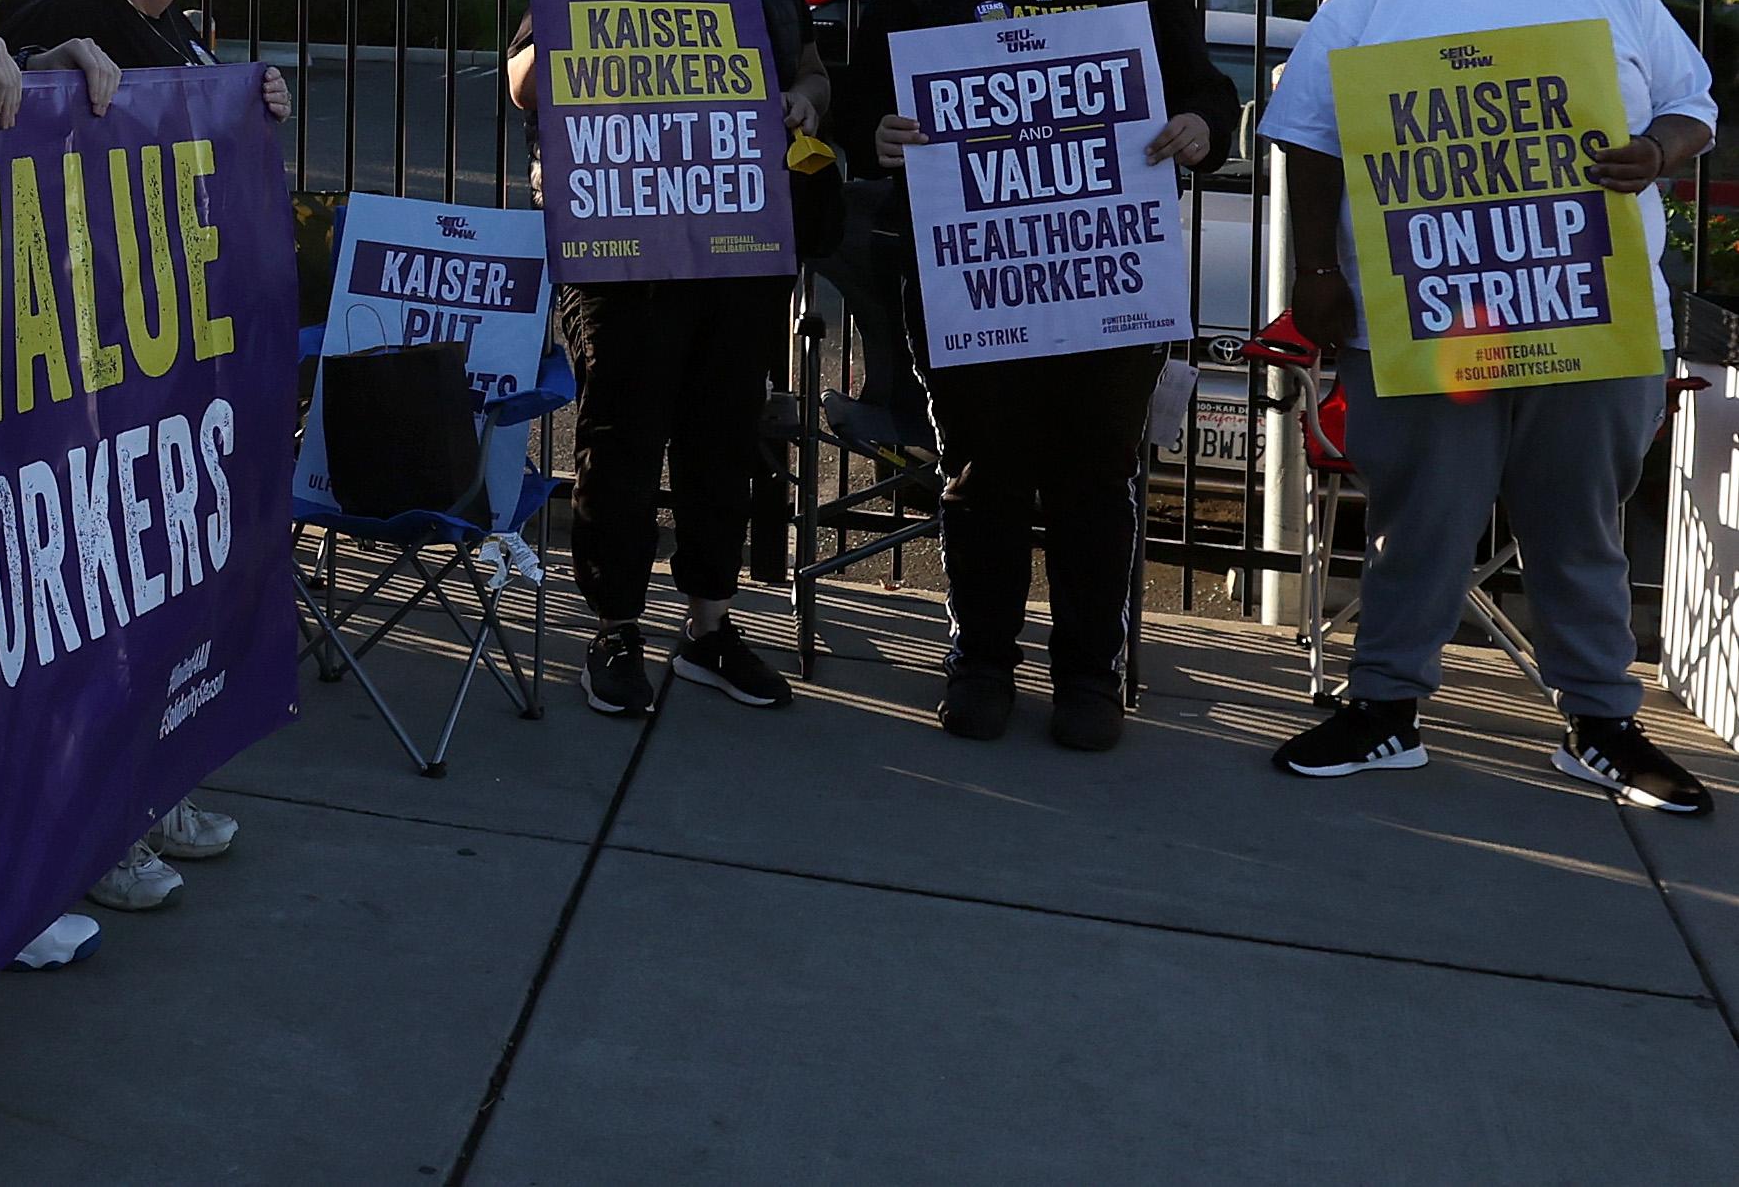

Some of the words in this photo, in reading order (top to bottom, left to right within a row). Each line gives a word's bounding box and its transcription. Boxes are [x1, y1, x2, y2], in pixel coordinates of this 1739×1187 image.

[587, 8, 722, 49] KAISER
[997, 28, 1035, 43] SEIU-
[1007, 39, 1047, 53] UHW
[564, 54, 753, 98] WORKERS
[1439, 46, 1480, 60] SEIU-
[1451, 55, 1493, 71] UHW
[929, 58, 1129, 133] RESPECT
[1389, 75, 1573, 145] KAISER
[565, 112, 698, 164] WON'T
[710, 111, 761, 159] BE
[1019, 125, 1053, 142] AND
[569, 164, 767, 218] SILENCED
[967, 138, 1112, 204] VALUE
[1364, 130, 1610, 206] WORKERS
[562, 241, 588, 259] ULP
[592, 240, 641, 257] STRIKE
[932, 201, 1164, 267] HEALTHCARE
[1408, 210, 1480, 270] ON
[1490, 200, 1586, 262] ULP
[380, 250, 515, 307] KAISER:
[963, 252, 1143, 311] WORKERS
[1418, 263, 1599, 332] STRIKE
[945, 331, 973, 351] ULP
[977, 327, 1029, 347] STRIKE
[1476, 342, 1557, 362] #UNITED4ALL
[1455, 358, 1581, 381] #SOLIDARITYSEASON
